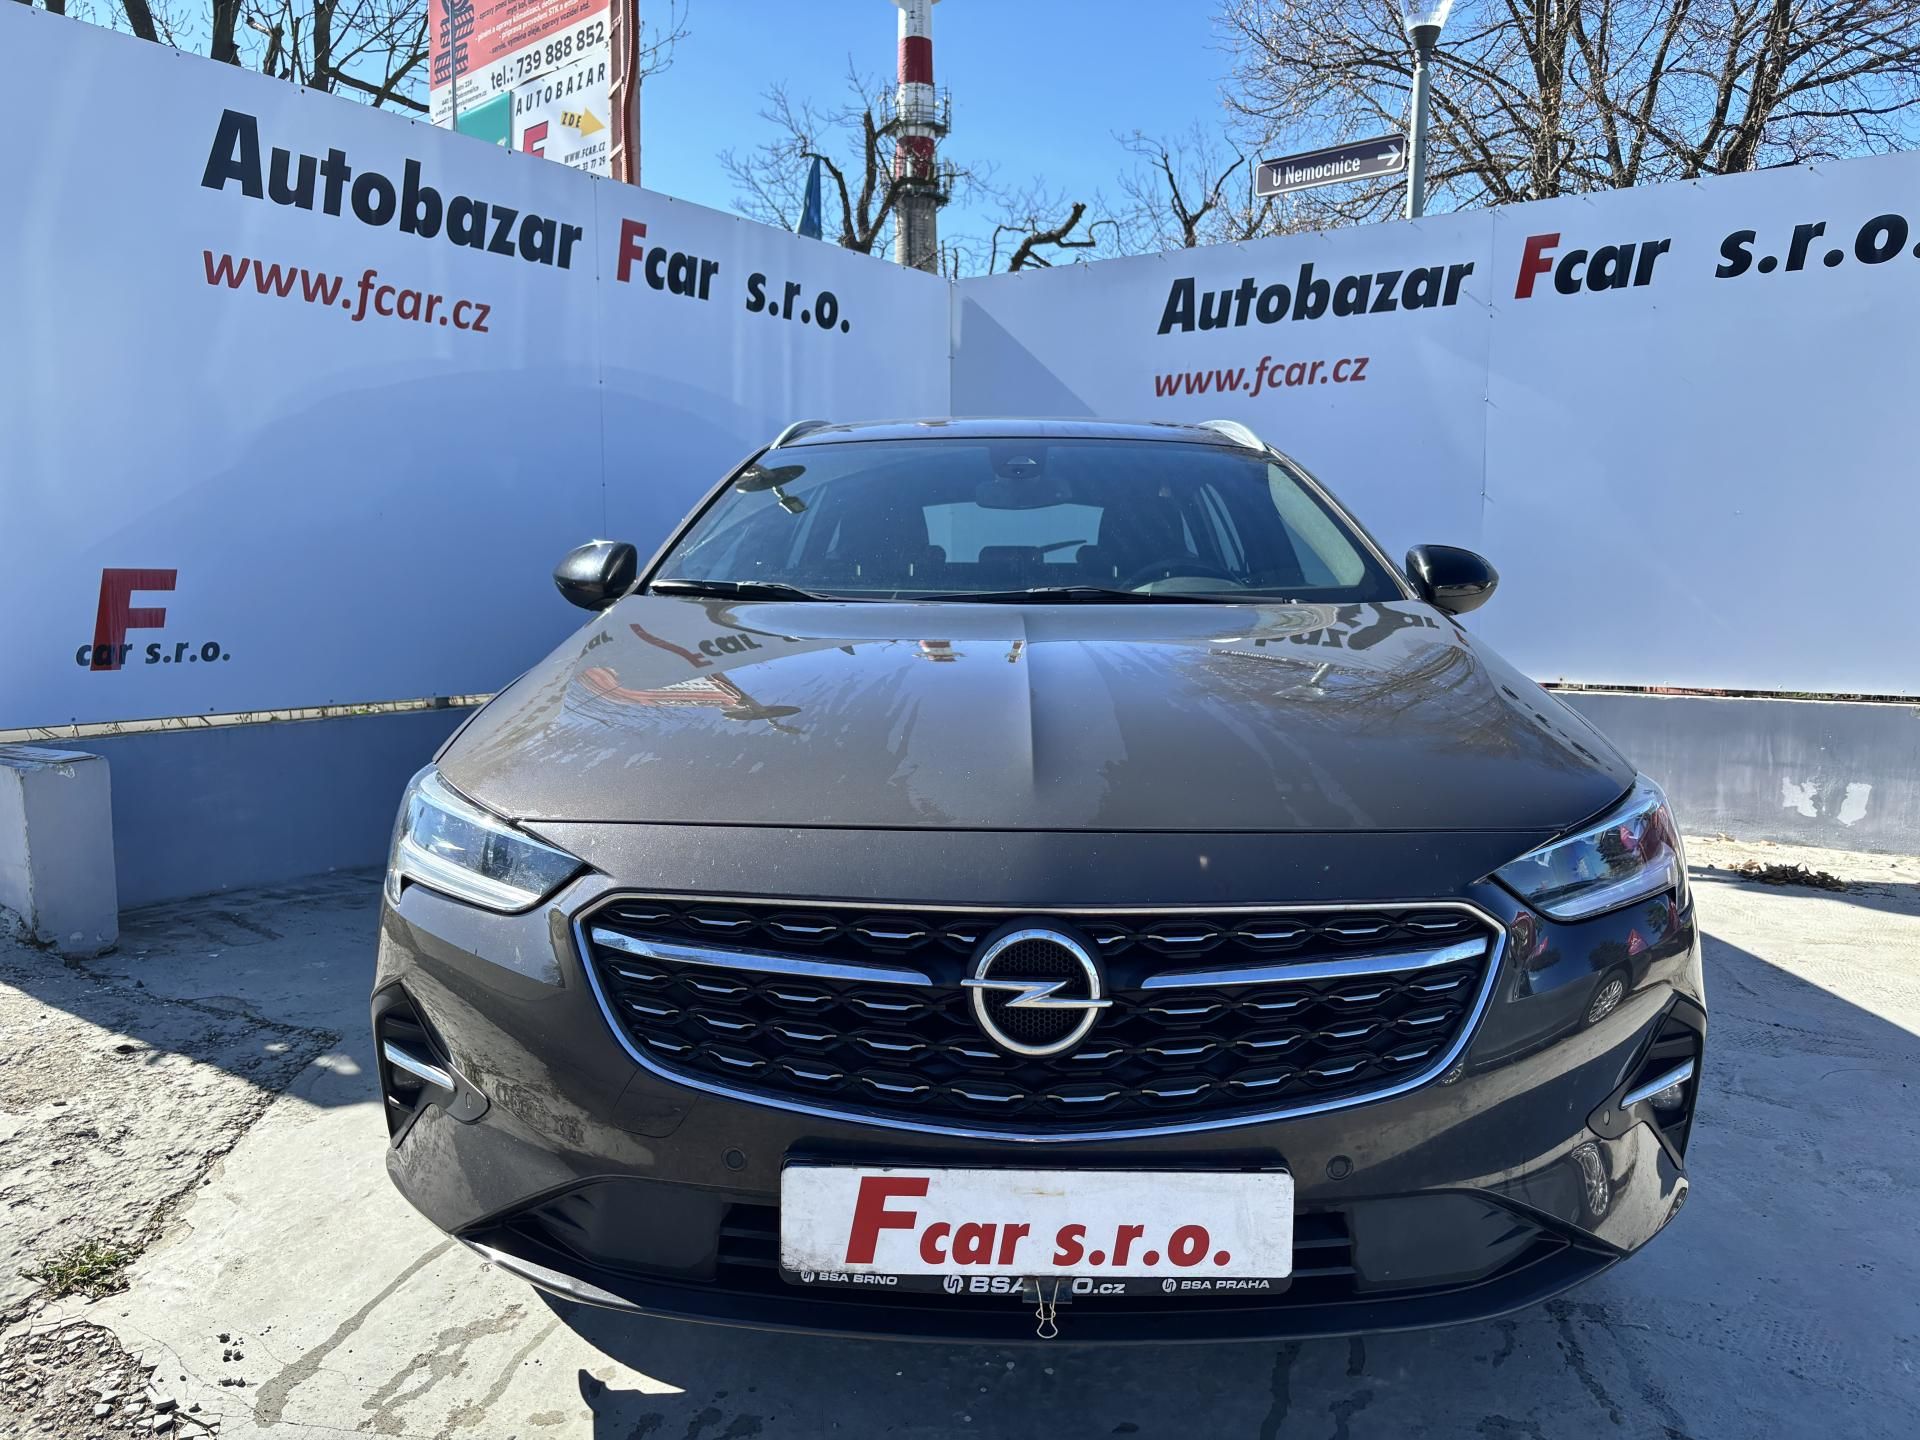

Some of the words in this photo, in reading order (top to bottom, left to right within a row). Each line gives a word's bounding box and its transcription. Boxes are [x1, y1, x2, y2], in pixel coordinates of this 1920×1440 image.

[490, 65, 514, 90] tel.:
[516, 54, 541, 78] 739
[545, 36, 572, 66] 888
[576, 21, 605, 51] 852
[516, 62, 605, 116] AUTOBAZAR
[561, 112, 582, 128] ZDE
[564, 141, 606, 164] WWW.FCAR.CZ
[1272, 168, 1281, 187] U
[1285, 155, 1361, 185] Nemocnice
[201, 108, 582, 269] Autobazar
[616, 218, 719, 300] Fcar
[745, 272, 850, 333] s.r.o.
[203, 249, 492, 333] www.fcar.cz
[1157, 262, 1475, 336] Autobazar
[1515, 232, 1672, 300] Fcar
[1154, 355, 1370, 398] www.fcar.cz
[145, 641, 231, 664] s.r.o.
[845, 1175, 1030, 1265] Fcar
[1052, 1223, 1232, 1267] s.r.o.
[818, 1272, 849, 1283] BSA
[852, 1273, 898, 1285] BRNO
[969, 1277, 1126, 1295] BSAO.cz
[1180, 1280, 1212, 1290] BSA
[1215, 1279, 1271, 1290] PRAHA
